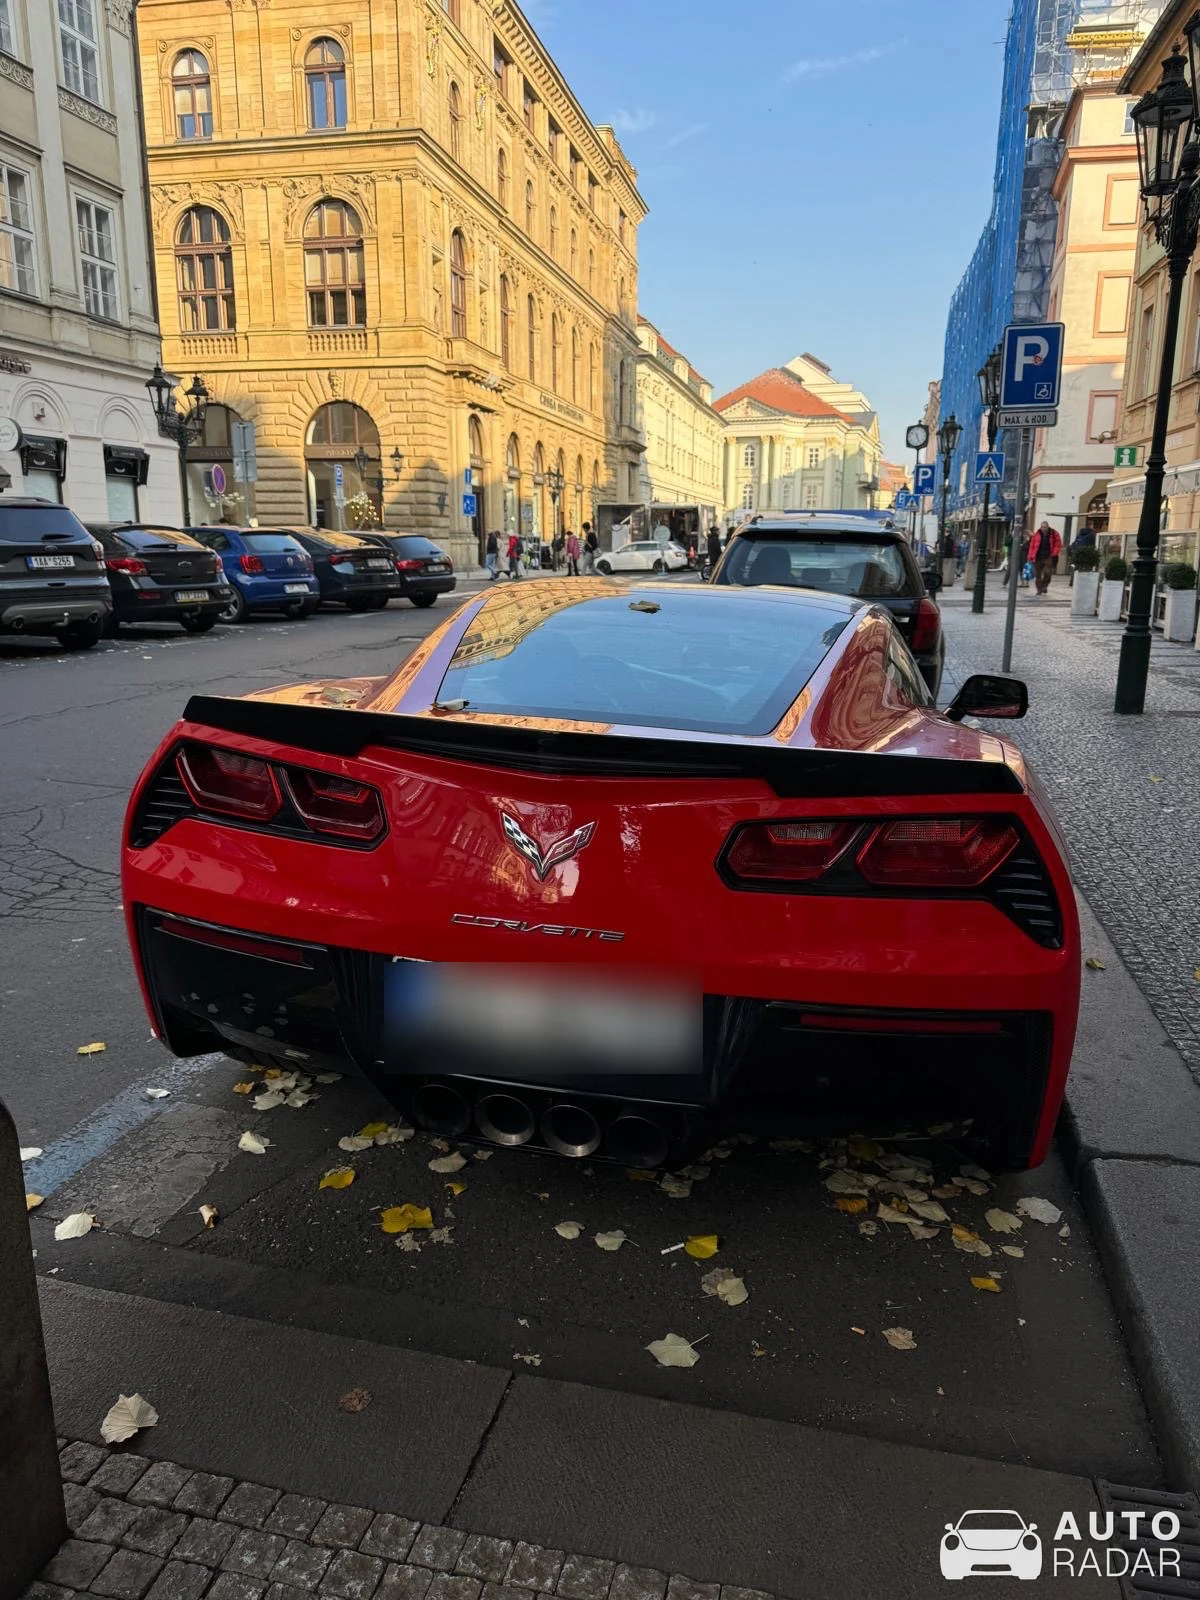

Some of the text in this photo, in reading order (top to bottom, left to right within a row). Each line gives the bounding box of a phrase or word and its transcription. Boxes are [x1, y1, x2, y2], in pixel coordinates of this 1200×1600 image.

[1014, 335, 1049, 382] P
[1004, 416, 1023, 425] MAX.
[1031, 415, 1049, 424] HOD.
[918, 467, 932, 487] P
[451, 913, 625, 941] CORVETTE
